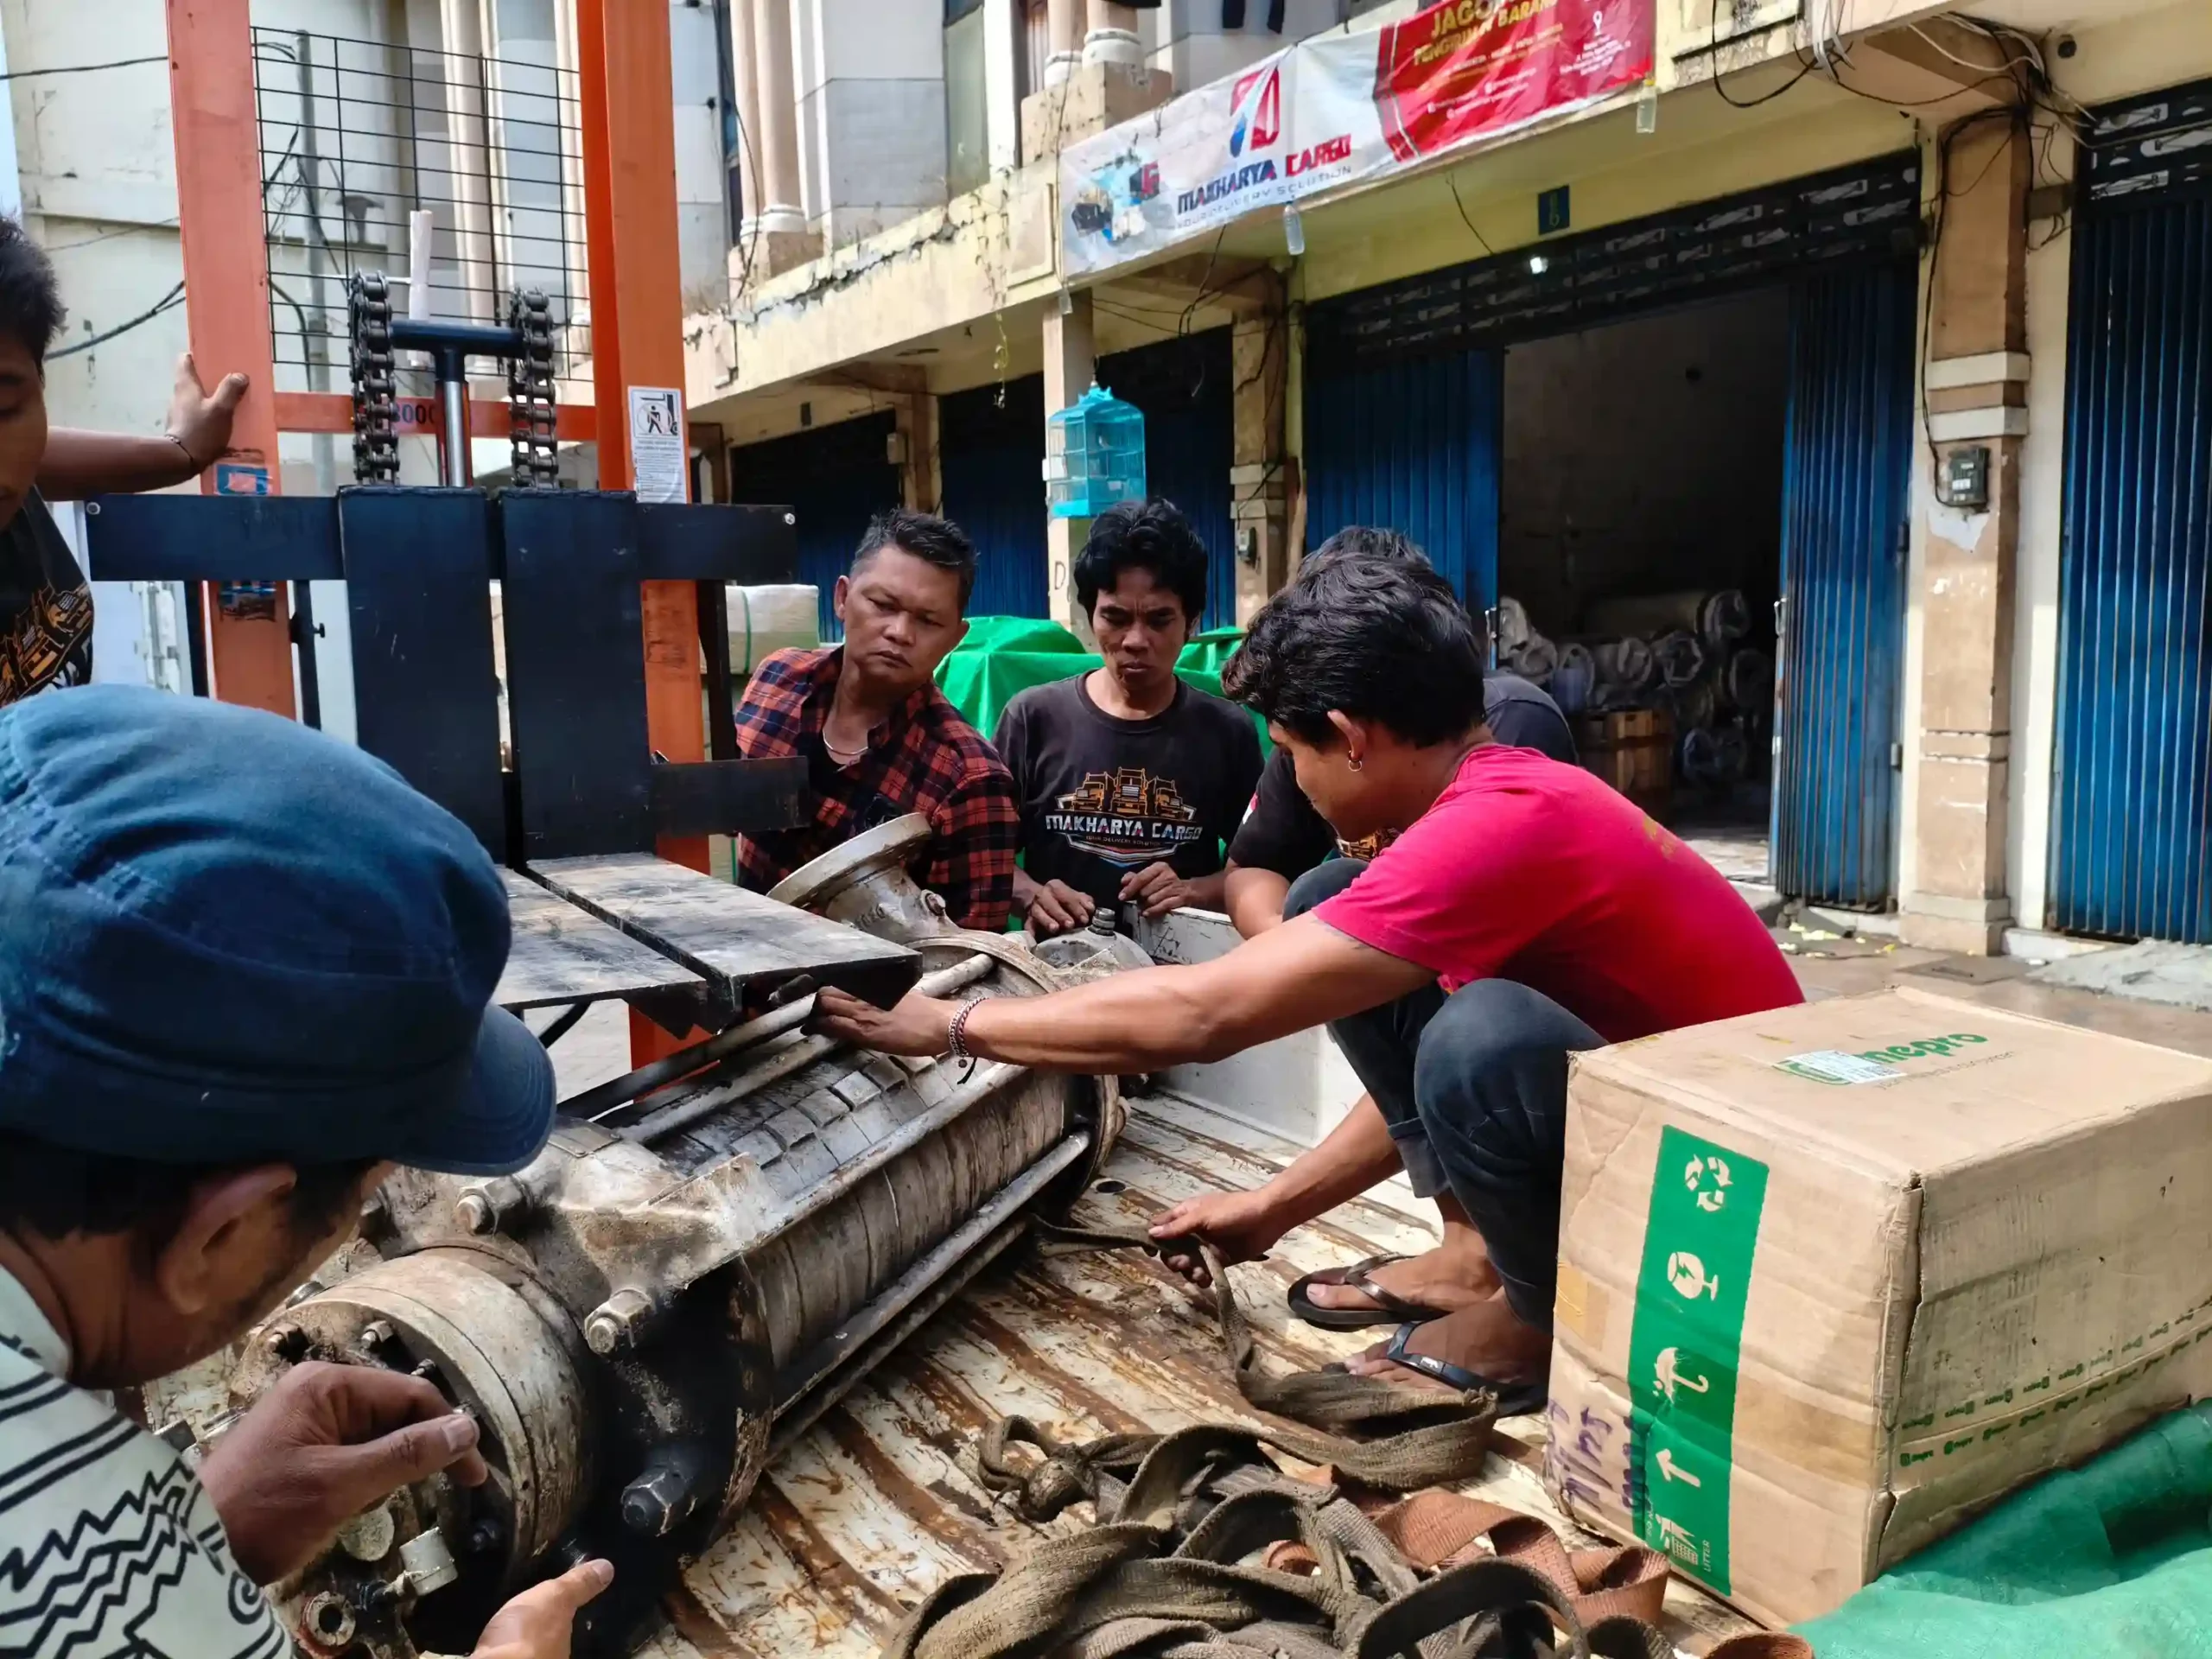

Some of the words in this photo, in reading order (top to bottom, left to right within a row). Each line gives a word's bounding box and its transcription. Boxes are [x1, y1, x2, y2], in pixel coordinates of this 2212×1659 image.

[1178, 159, 1277, 215] MAKHARYA
[1285, 133, 1351, 178] CARGO
[1045, 814, 1144, 837] MAKHARYA
[1152, 822, 1203, 842] CARGO
